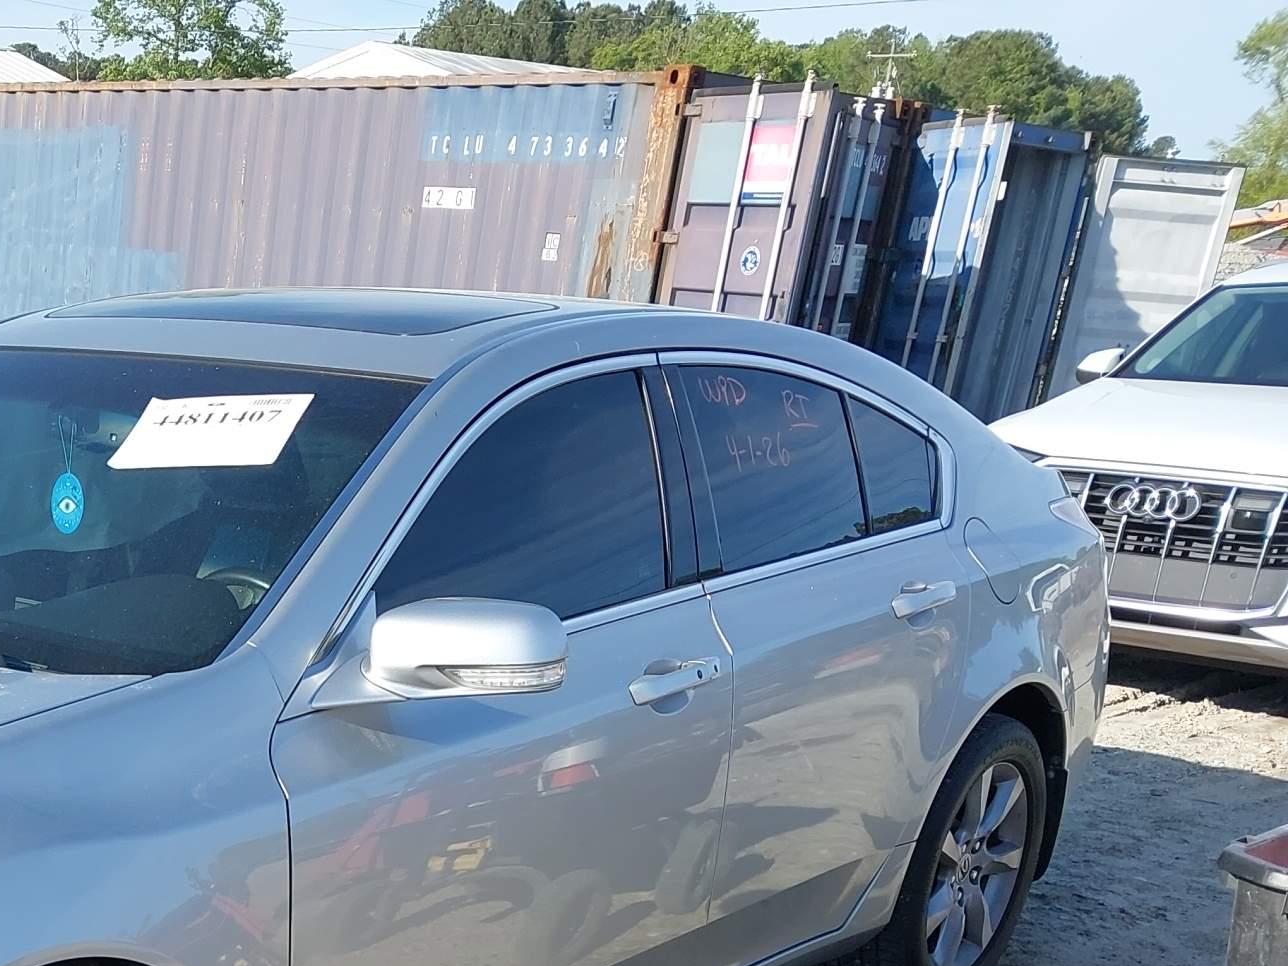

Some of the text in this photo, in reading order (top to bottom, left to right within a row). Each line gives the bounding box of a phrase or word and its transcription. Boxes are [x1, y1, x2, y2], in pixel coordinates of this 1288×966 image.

[908, 216, 932, 242] AP
[153, 409, 283, 427] 44811407
[781, 389, 809, 419] RT
[725, 432, 791, 473] 4-1-26
